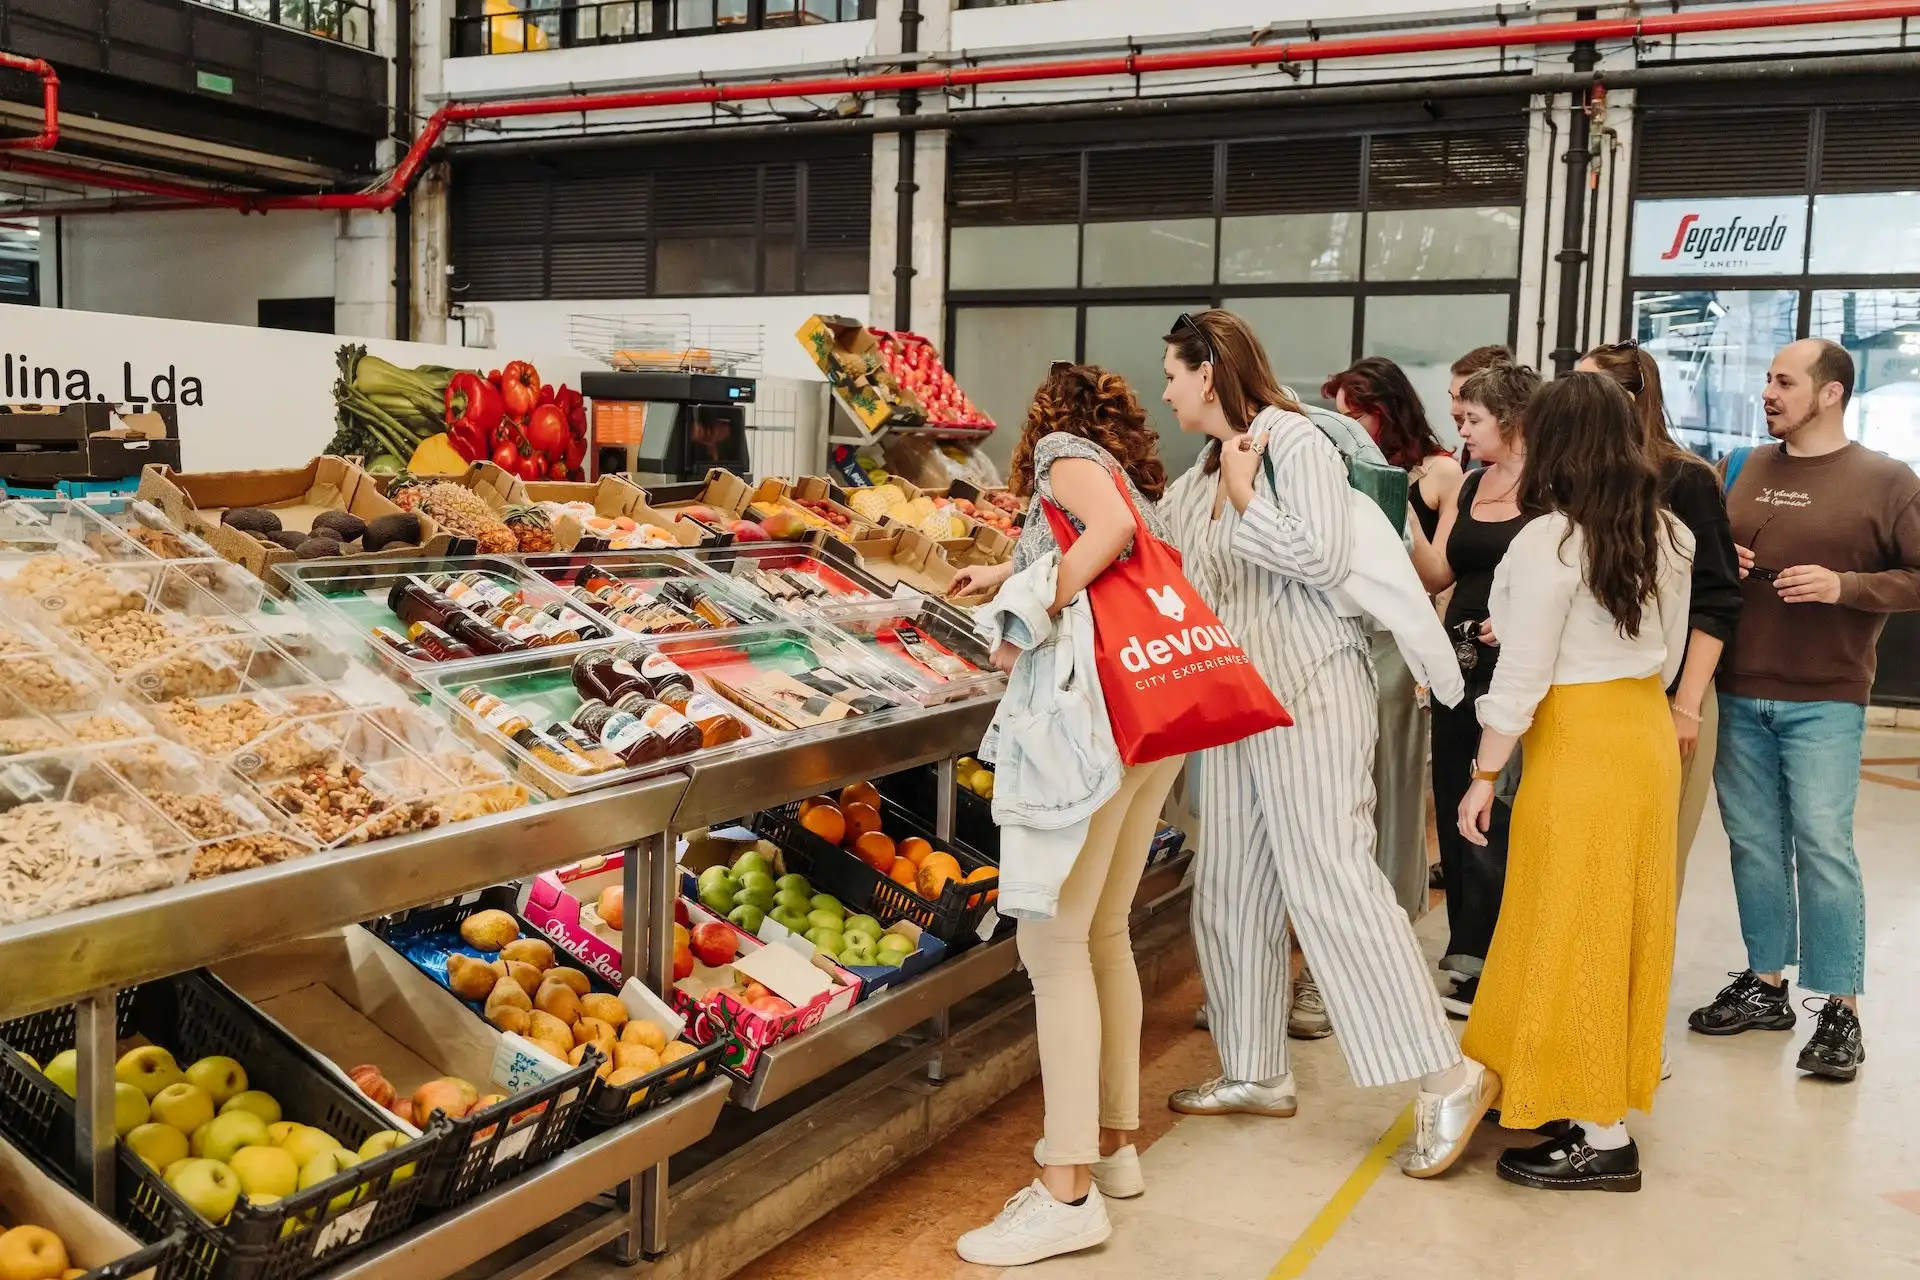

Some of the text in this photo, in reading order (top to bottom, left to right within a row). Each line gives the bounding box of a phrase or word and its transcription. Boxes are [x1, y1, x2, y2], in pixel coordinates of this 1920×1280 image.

[1660, 214, 1788, 260] Segafredo
[1703, 260, 1748, 268] ZANETTI
[123, 361, 204, 407] Lda
[1135, 674, 1167, 691] CITY
[545, 918, 590, 959] Pink
